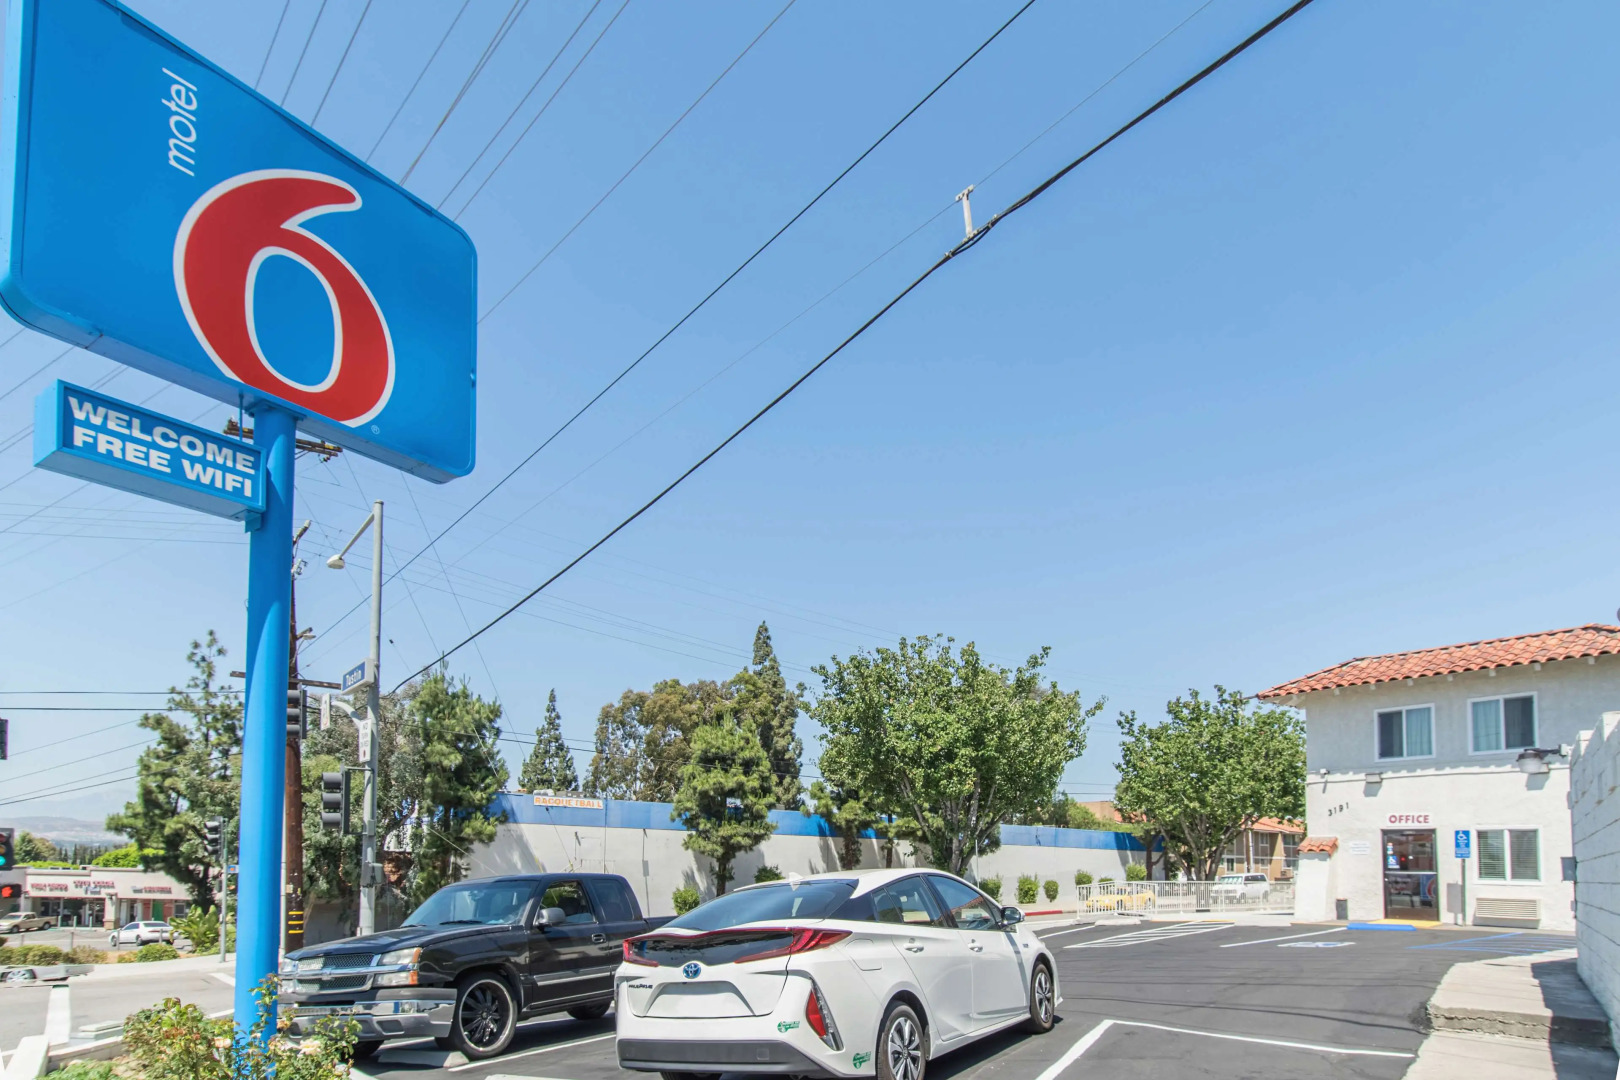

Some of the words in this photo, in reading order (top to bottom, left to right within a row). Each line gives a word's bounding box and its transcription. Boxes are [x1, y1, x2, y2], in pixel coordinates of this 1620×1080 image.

[161, 67, 198, 177] motel
[173, 168, 396, 428] 6
[67, 396, 255, 475] WELCOME
[73, 425, 171, 473] FREE
[181, 458, 252, 498] WIFI
[345, 669, 362, 687] Tustin
[534, 796, 602, 808] RACQUETBALL
[1328, 802, 1349, 817] 3191
[1388, 814, 1430, 824] OFFICE
